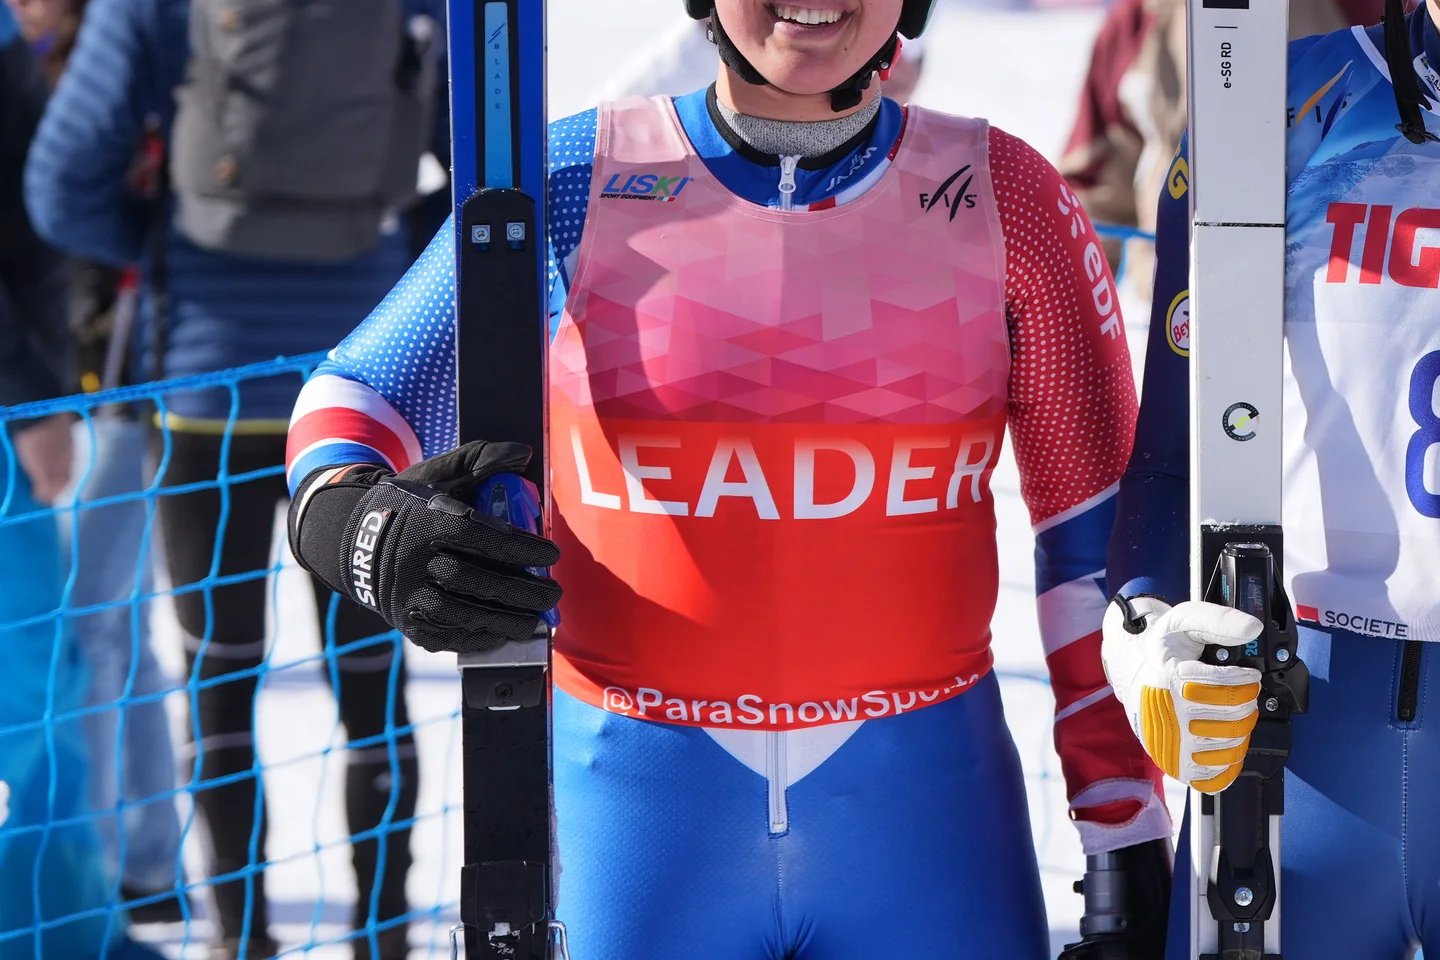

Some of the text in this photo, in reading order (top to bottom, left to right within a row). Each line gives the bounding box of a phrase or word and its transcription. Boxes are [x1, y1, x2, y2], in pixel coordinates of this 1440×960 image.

[1220, 42, 1232, 89] e-SG RD
[602, 174, 691, 196] LISKI
[620, 193, 657, 201] EQUIPMENT
[570, 424, 995, 520] LEADER
[353, 510, 383, 608] SHRED
[1325, 610, 1408, 637] SOCIETE
